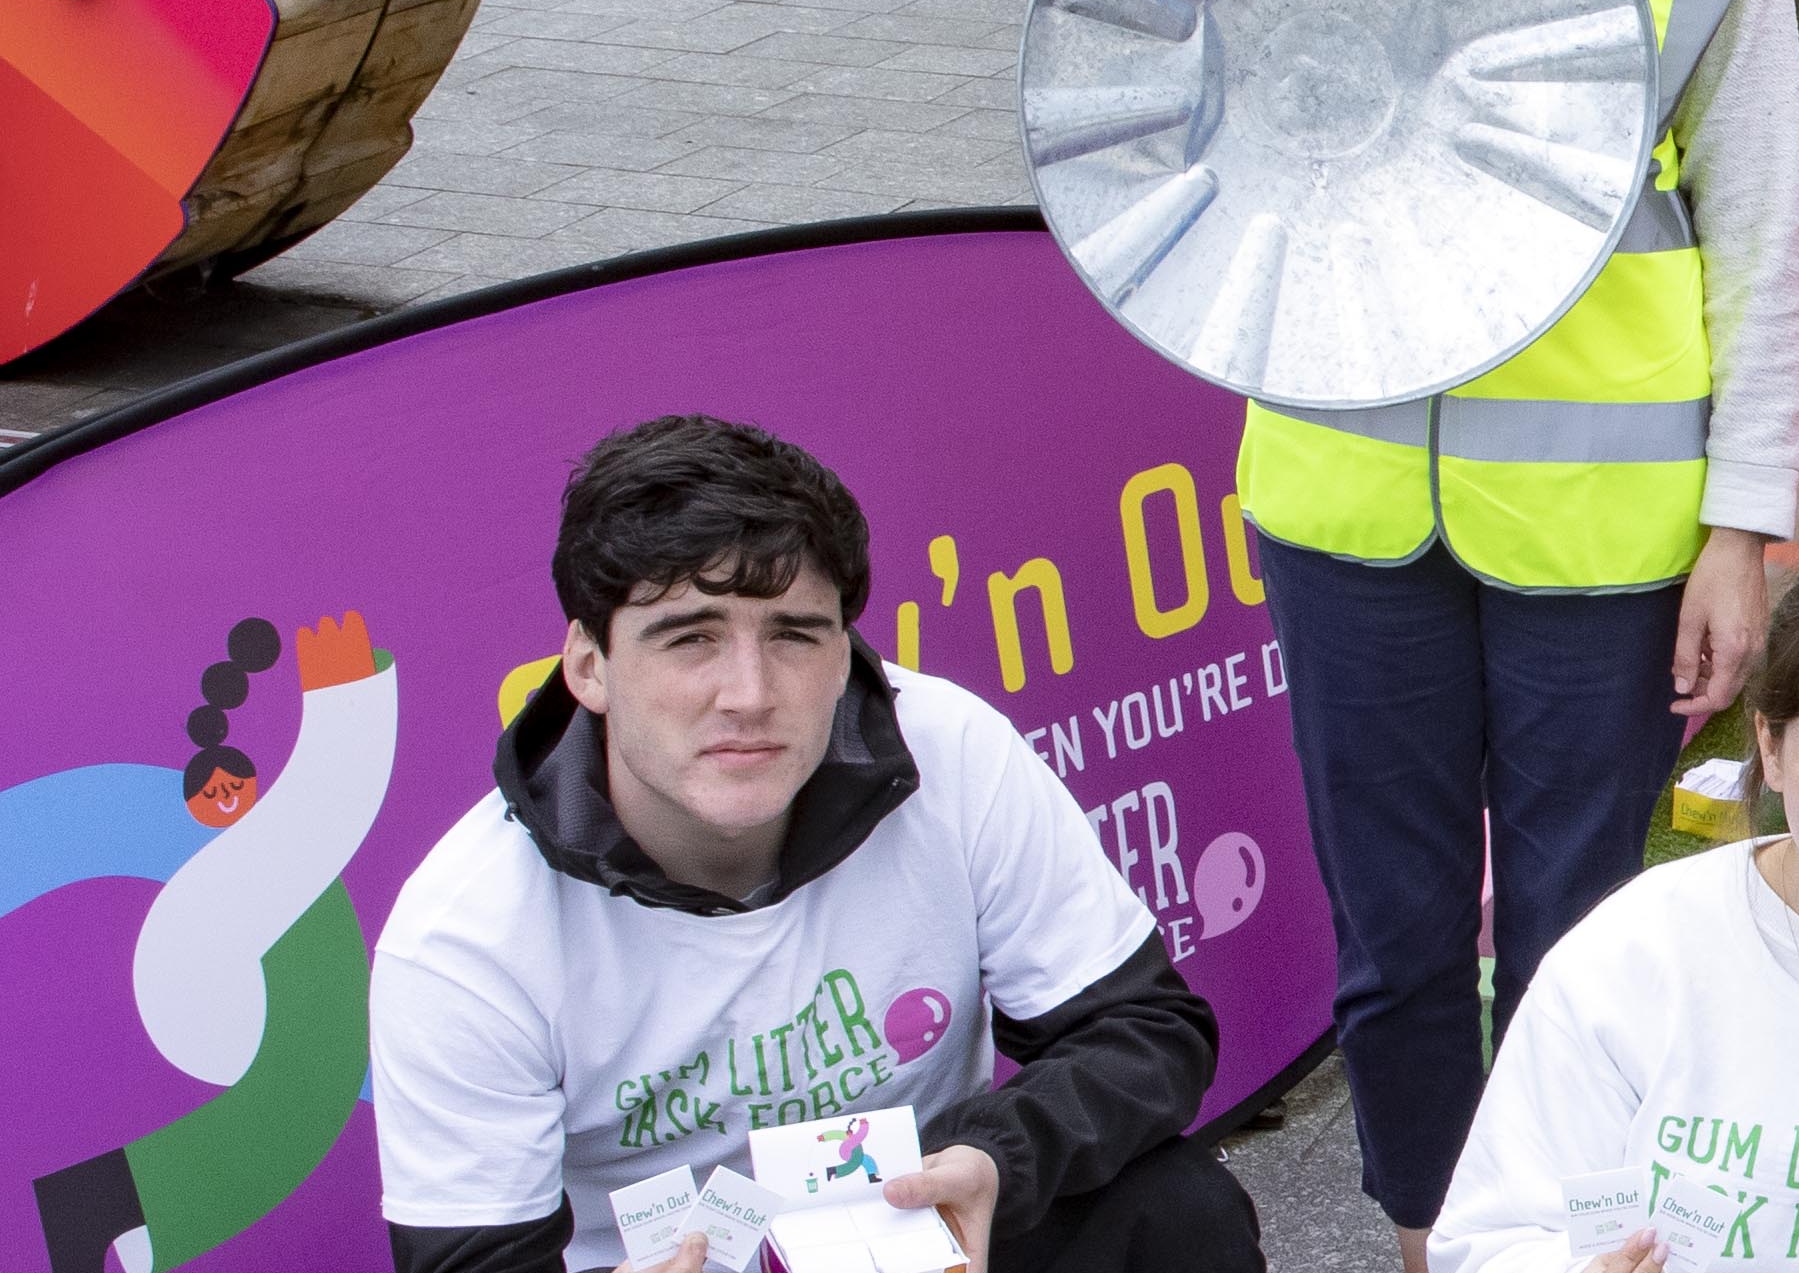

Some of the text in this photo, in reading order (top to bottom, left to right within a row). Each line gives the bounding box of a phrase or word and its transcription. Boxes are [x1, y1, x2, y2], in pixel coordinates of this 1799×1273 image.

[1091, 652, 1253, 760] YOU'RE
[728, 968, 882, 1096] LITTER
[620, 1054, 893, 1148] TASK FORCE
[1657, 1115, 1763, 1179] GUM
[619, 1202, 665, 1228] Chew'n
[667, 1190, 691, 1210] Out
[702, 1189, 743, 1216] Chew'n
[743, 1208, 767, 1227] Out
[1568, 1195, 1613, 1213] Chew'n
[1616, 1189, 1640, 1205] Out
[1662, 1196, 1702, 1224] Chew'n
[1703, 1216, 1726, 1234] Out
